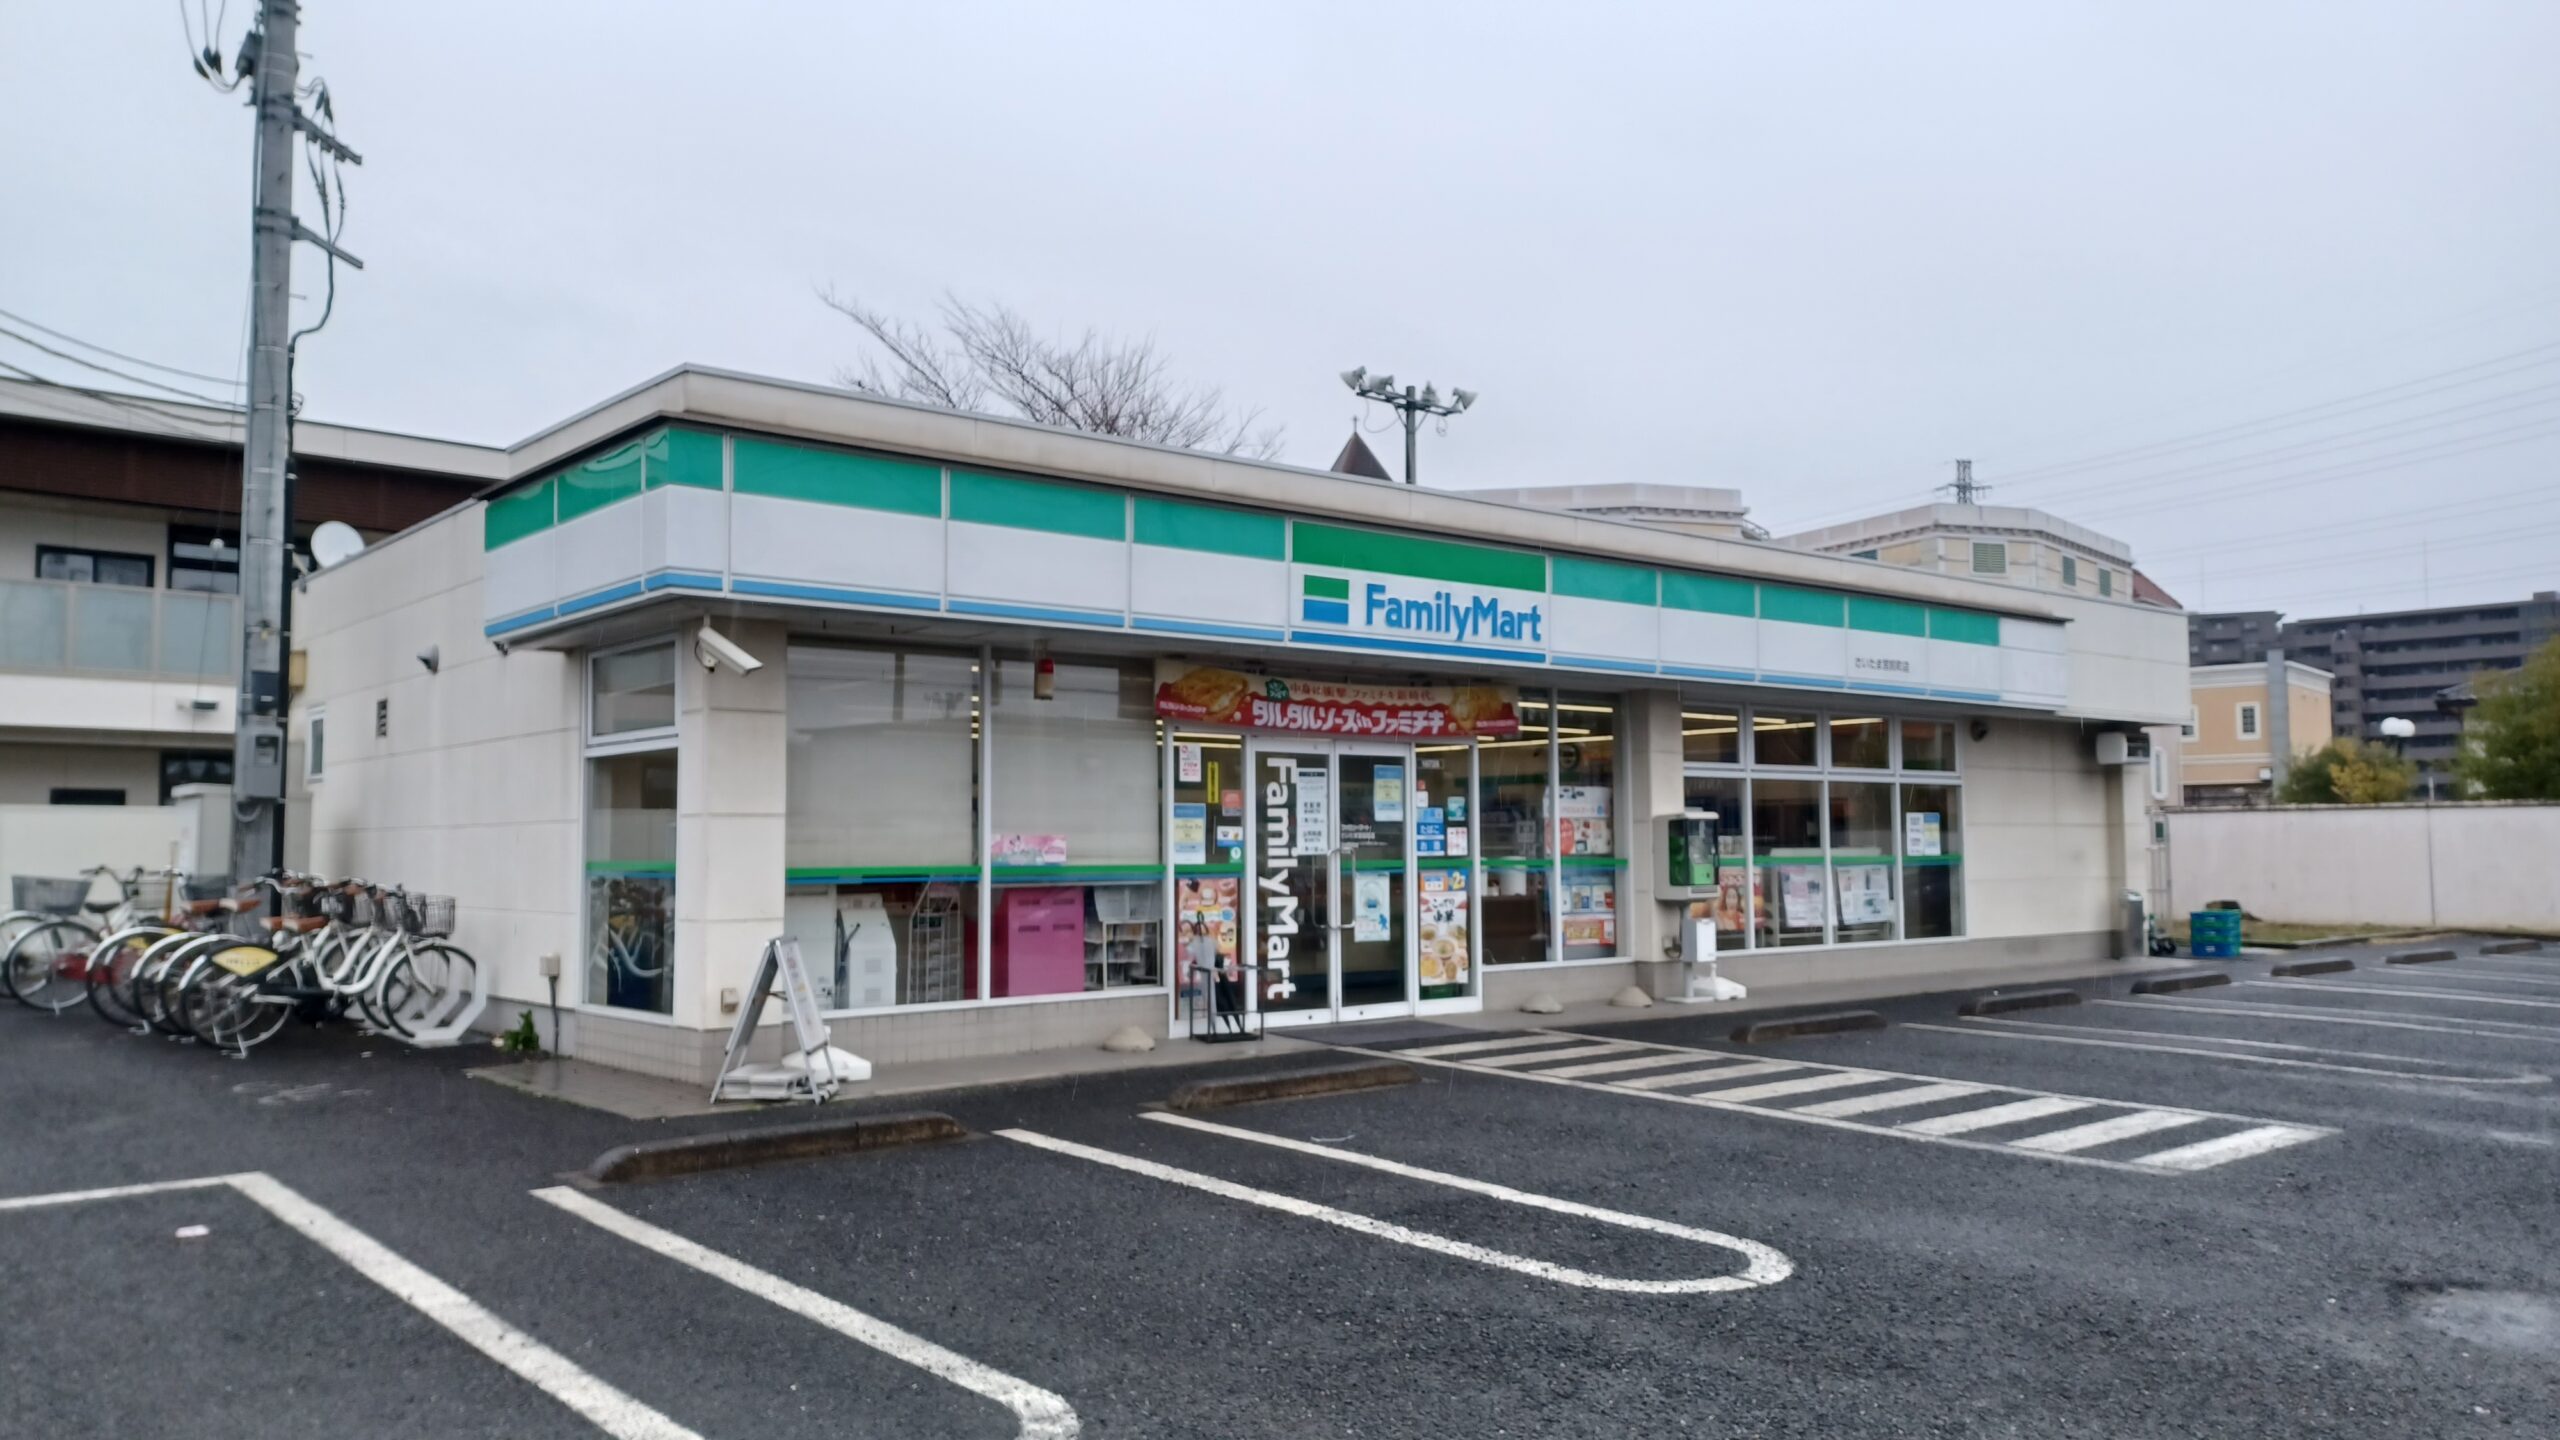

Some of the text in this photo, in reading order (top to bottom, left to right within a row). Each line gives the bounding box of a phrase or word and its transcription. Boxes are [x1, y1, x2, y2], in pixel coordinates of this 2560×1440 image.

[1366, 583, 1541, 641] FamilyMart
[1253, 701, 1445, 735] タルタルソースinファミチキ
[1420, 825, 1440, 834] たばこ
[1258, 757, 1299, 1000] FamilyMart
